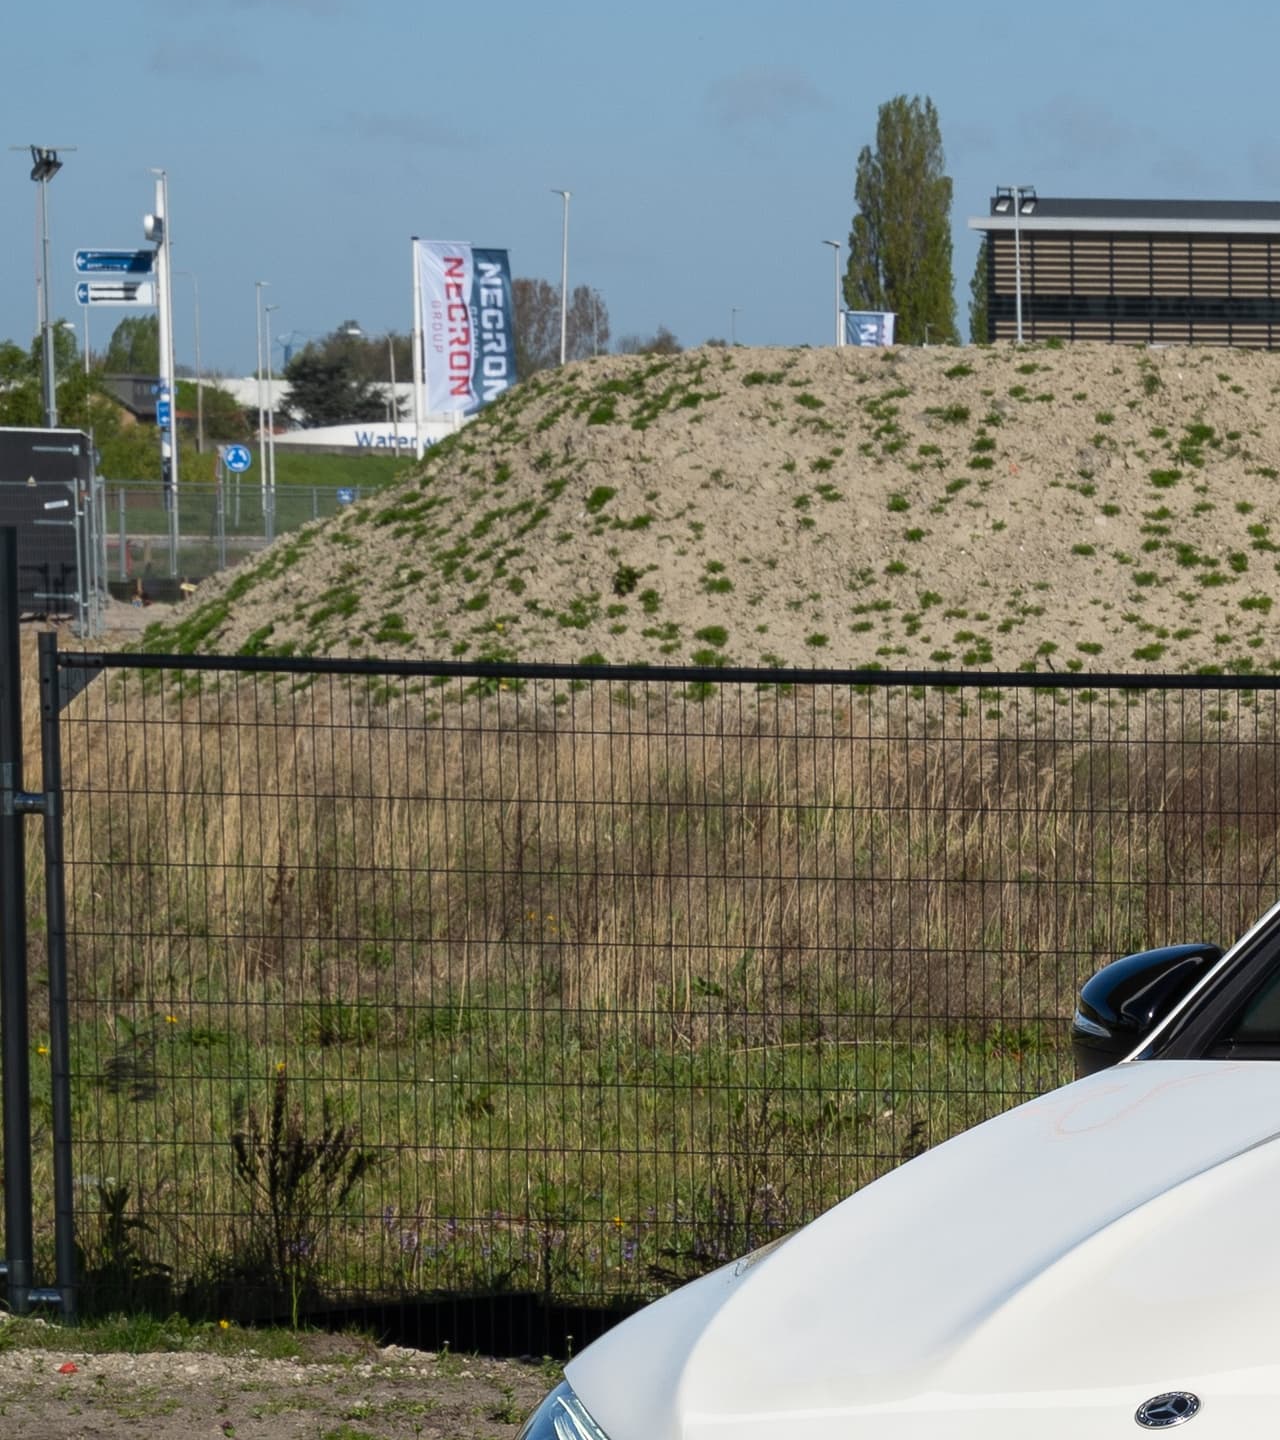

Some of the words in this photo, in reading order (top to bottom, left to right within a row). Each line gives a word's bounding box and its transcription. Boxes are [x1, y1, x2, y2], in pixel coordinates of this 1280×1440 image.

[431, 300, 443, 353] GROUP
[443, 256, 470, 396] NECRON
[478, 262, 508, 402] NECRON
